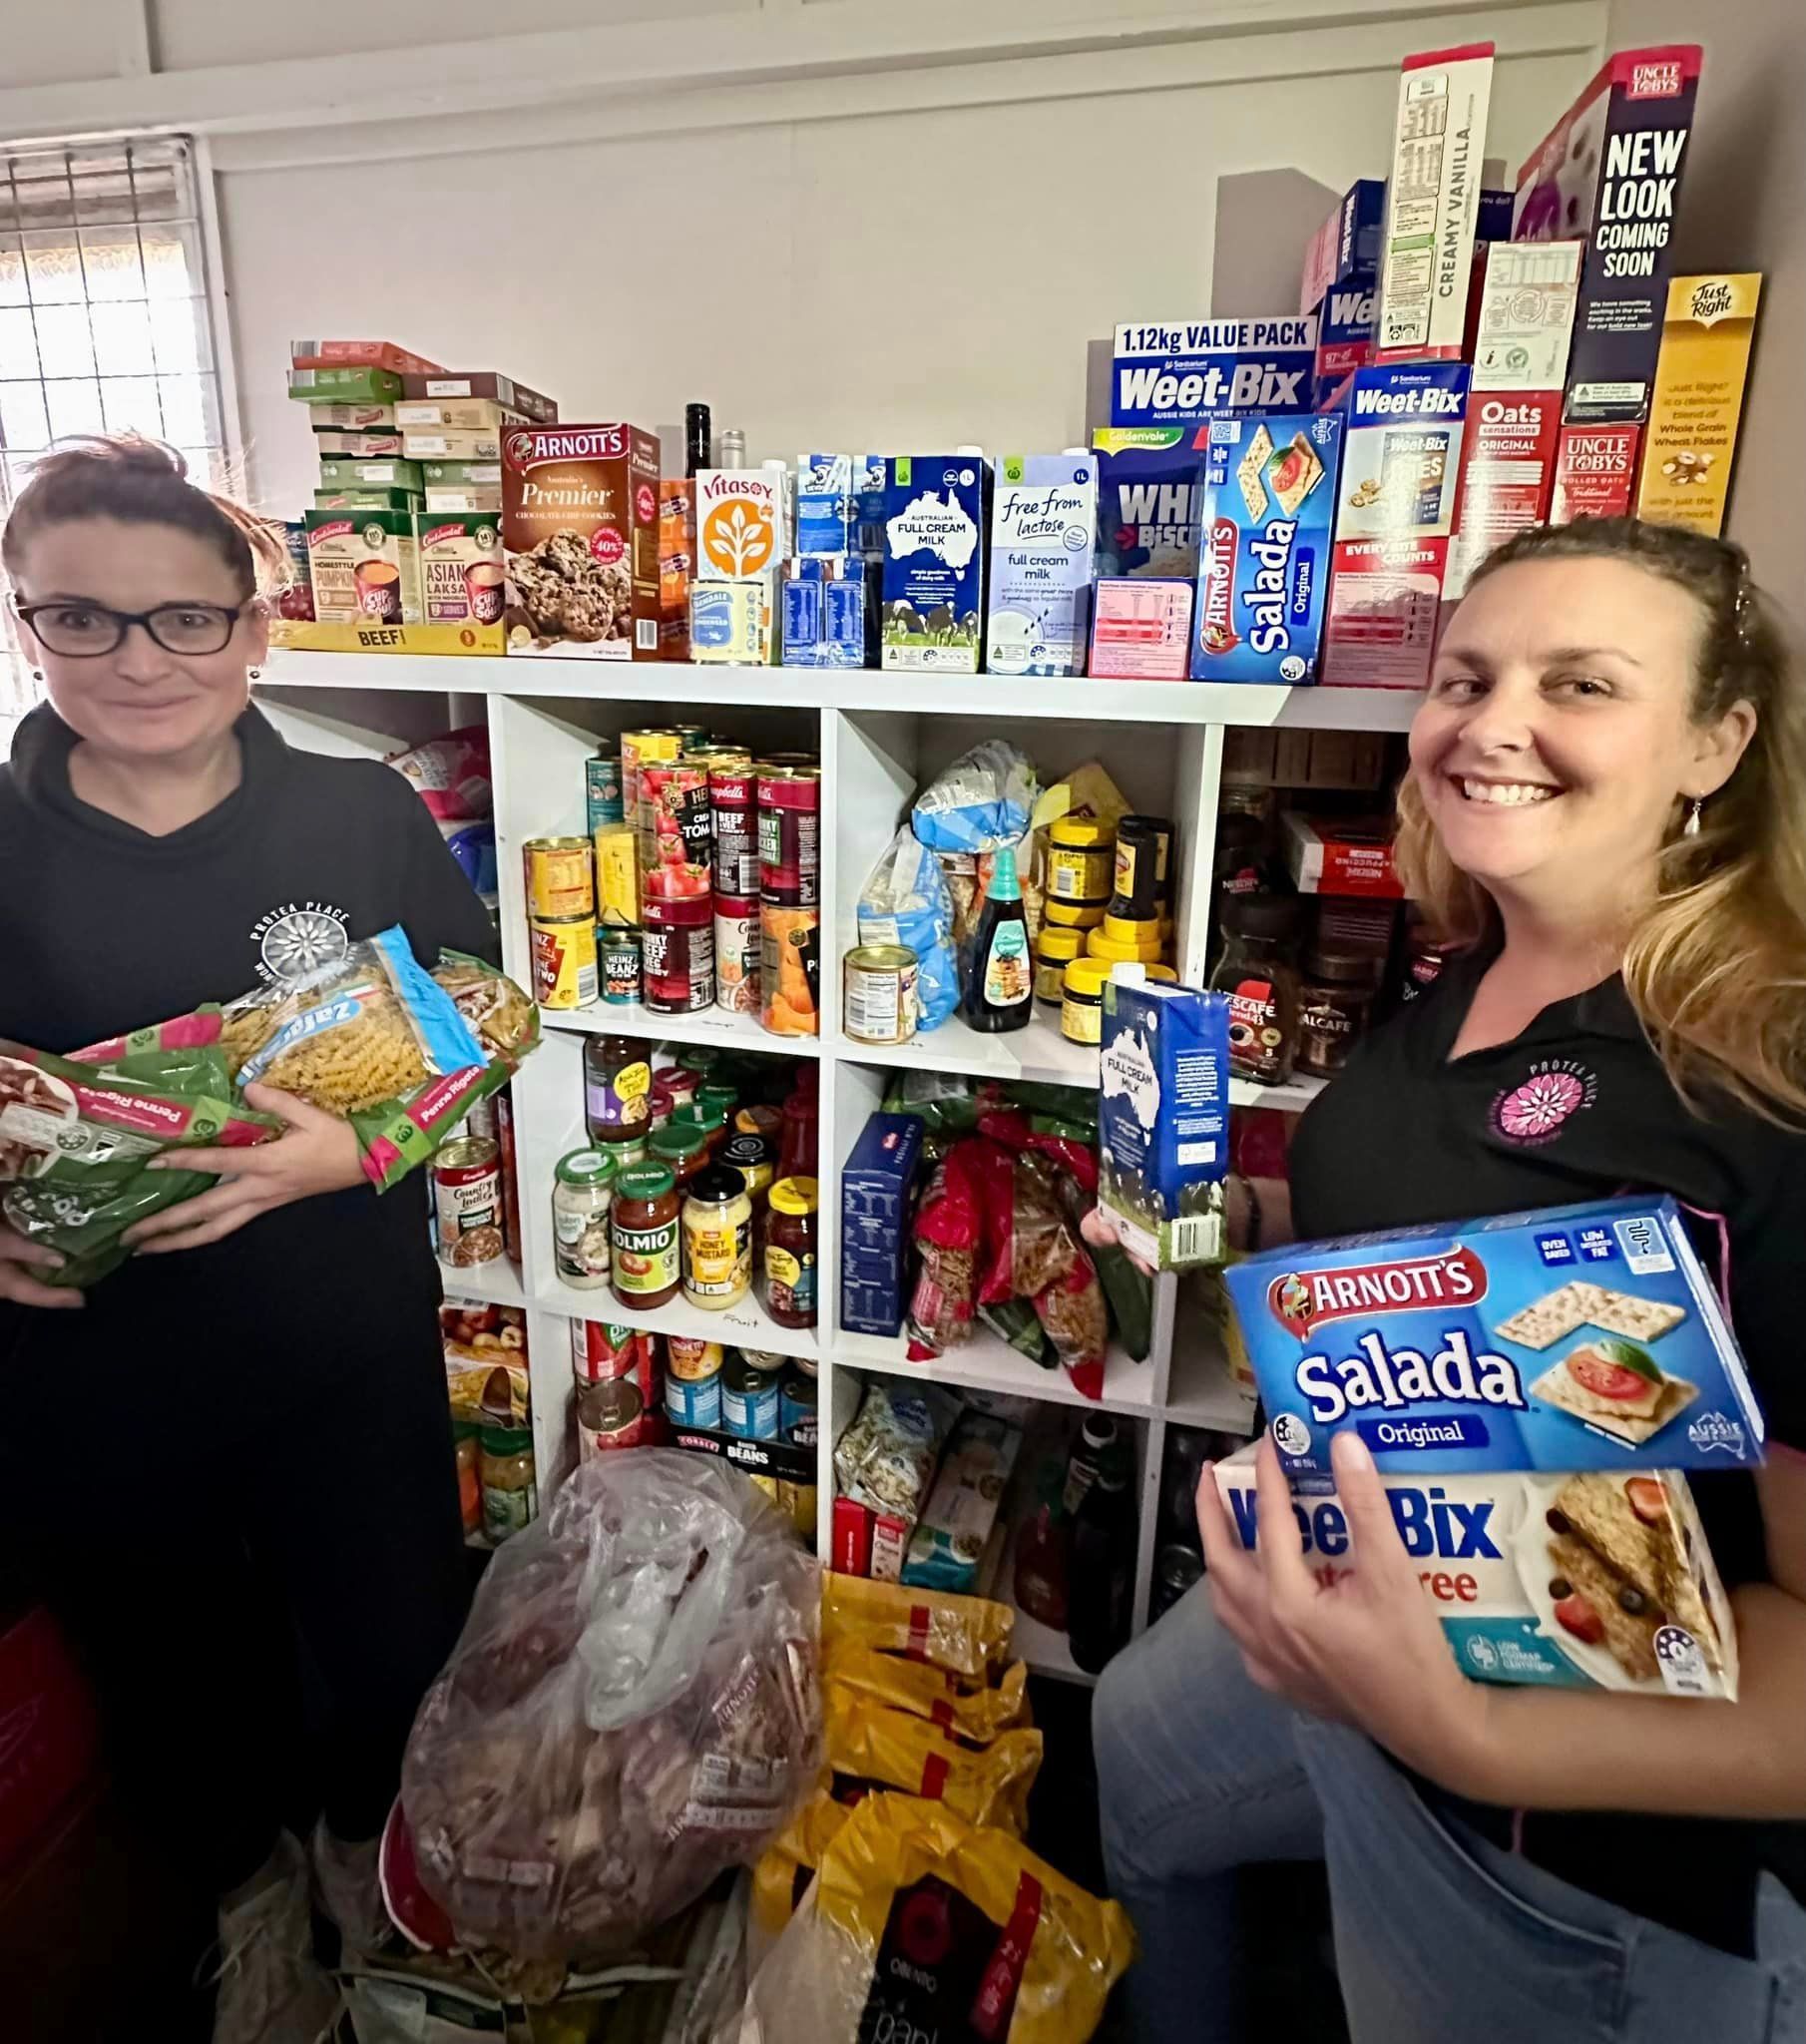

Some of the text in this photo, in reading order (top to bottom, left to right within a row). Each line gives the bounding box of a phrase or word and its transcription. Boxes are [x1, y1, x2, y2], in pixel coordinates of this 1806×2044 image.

[1633, 63, 1679, 80] UNCLE
[1631, 78, 1678, 95] TOBYS
[1605, 129, 1687, 179] NEW
[1599, 178, 1677, 221] LOOK
[1438, 127, 1471, 298] CREAMY VANILLA
[1596, 222, 1669, 251] COMING
[1603, 250, 1655, 277] SOON
[1692, 282, 1729, 300] Just
[1691, 297, 1732, 317] Right
[1124, 321, 1307, 353] 1.12kg VALUE PACK
[1173, 359, 1208, 368] Sanitarium
[1120, 362, 1305, 410] Weet-Bix
[1355, 388, 1465, 415] Weet-Bix
[1178, 410, 1196, 419] KIDS
[1481, 401, 1542, 424] Oats
[1109, 431, 1169, 443] Goldenvale
[1483, 425, 1538, 435] sensations
[1659, 423, 1727, 433] Whole Grain
[535, 431, 623, 457] ARNOTT'S
[1479, 440, 1537, 451] ORIGINAL
[1567, 438, 1630, 455] UNCLE
[1654, 436, 1728, 447] Wheat Flakes
[1566, 454, 1628, 471] TOBYS
[520, 482, 612, 506] Premier
[1002, 489, 1084, 523] free from
[897, 523, 967, 533] FULL CREAM
[1016, 517, 1065, 537] lactose
[917, 535, 946, 545] MILK
[1345, 542, 1385, 557] EVERY
[1008, 553, 1069, 566] full cream
[426, 564, 466, 583] ASIAN
[1025, 568, 1051, 579] milk
[1209, 526, 1234, 626] ARNOTT'S
[426, 583, 466, 595] LAKSA
[1244, 519, 1297, 654] Salada
[1293, 561, 1310, 614] Original
[358, 629, 406, 647] BEEF!
[717, 812, 745, 824] BEEF
[249, 901, 350, 940] PROTEA PLACE
[608, 955, 634, 964] HEINZ
[644, 944, 669, 959] EEF
[606, 964, 640, 975] BEANZ
[1108, 1058, 1153, 1086] FULL CREAM
[1122, 1078, 1139, 1094] MILK
[133, 1099, 182, 1124] Penne
[420, 1092, 453, 1123] Penne
[453, 1180, 493, 1201] Country
[615, 1230, 670, 1251] OLMIO
[699, 1239, 726, 1250] HONEY
[1542, 1239, 1567, 1251] OVEN
[1580, 1230, 1604, 1242] LOW
[695, 1248, 731, 1260] MUSTARD
[1544, 1249, 1571, 1261] BAKED
[1590, 1247, 1609, 1258] FAT
[1313, 1260, 1475, 1312] ARNOTT'S
[1295, 1331, 1524, 1422] Salada
[1378, 1420, 1465, 1447] Original
[1688, 1422, 1741, 1437] AUSSIE
[726, 1444, 769, 1465] BEANS
[1419, 1571, 1479, 1603] ree
